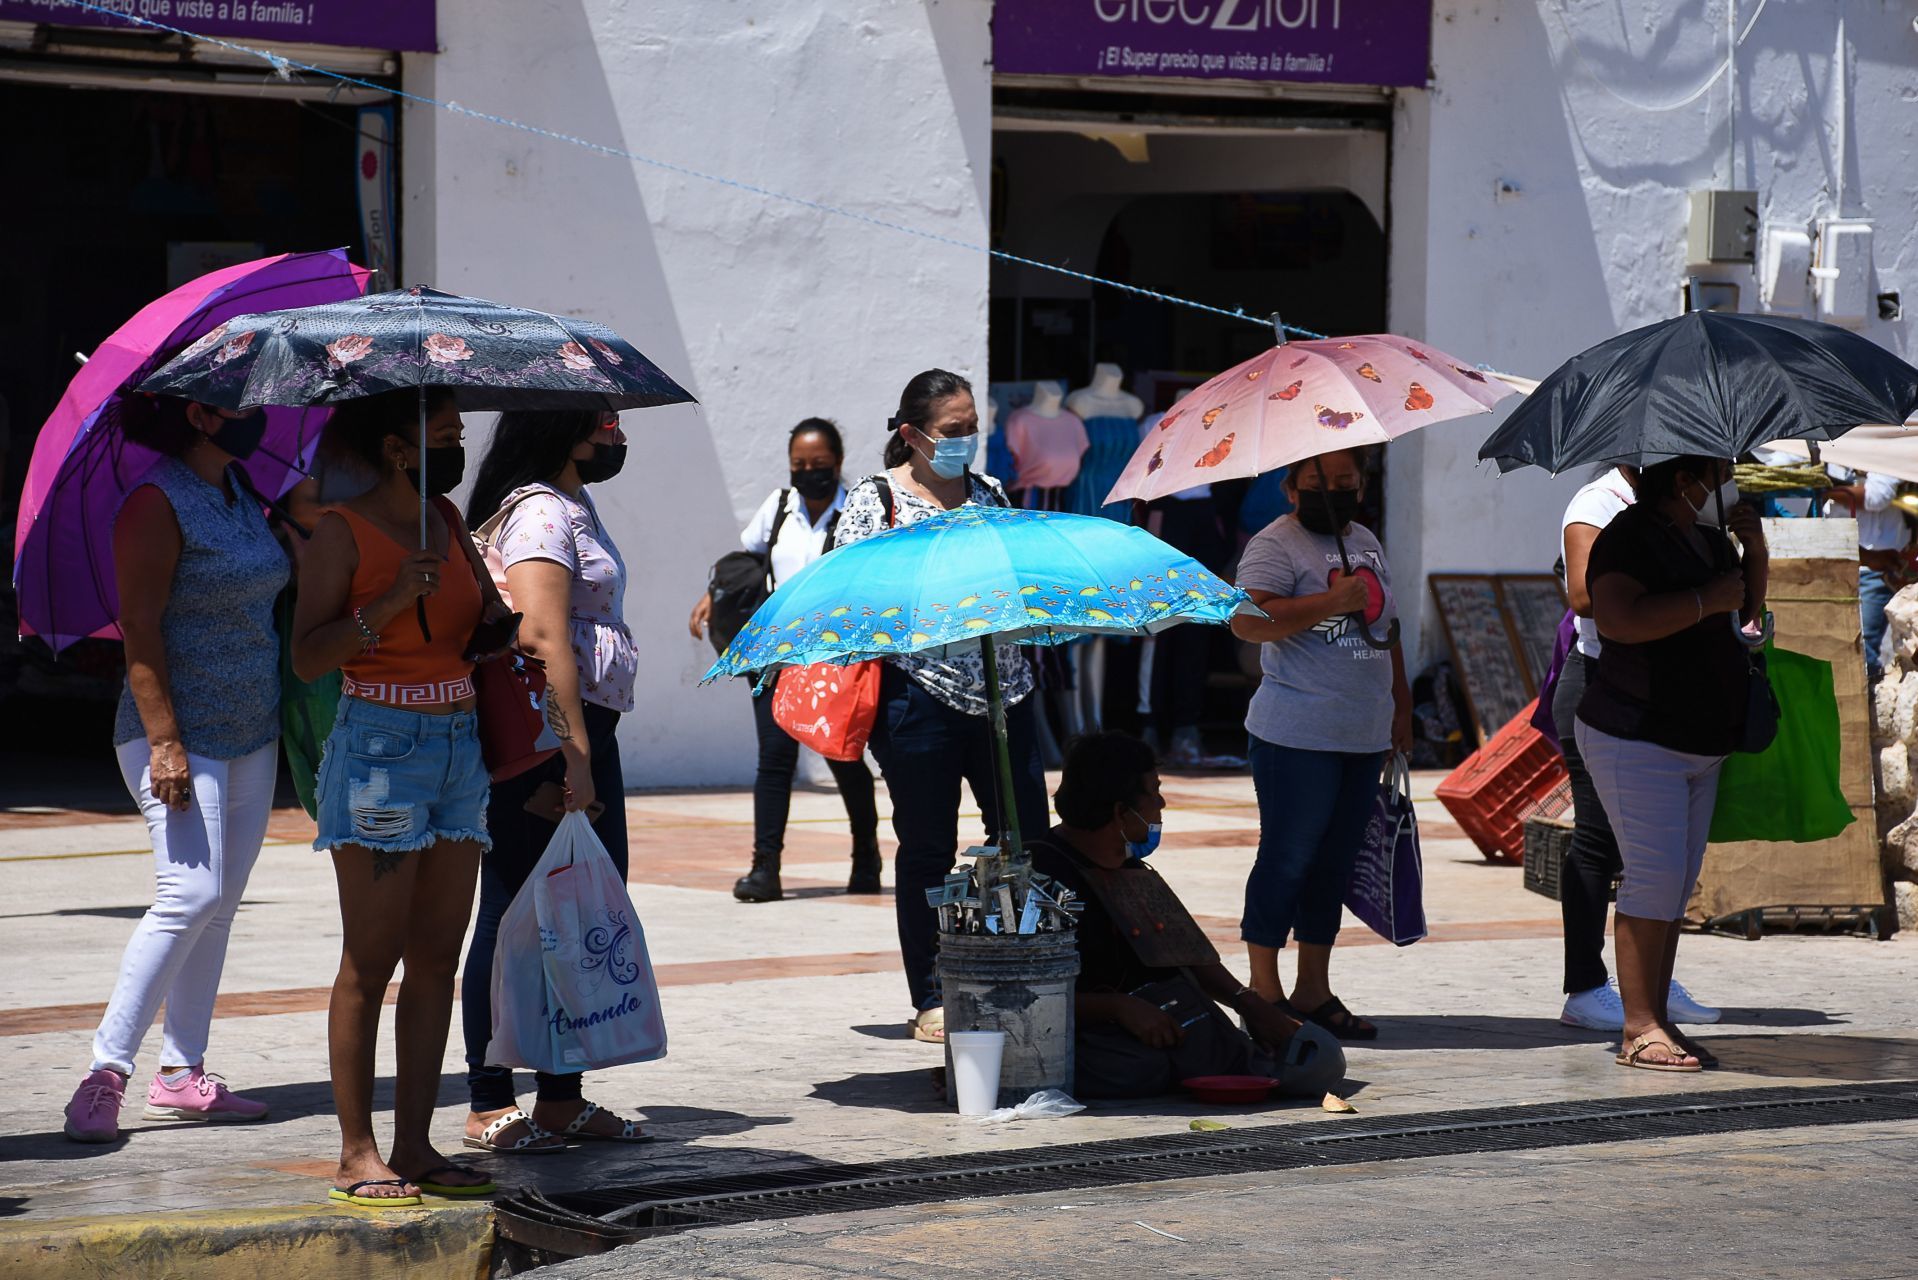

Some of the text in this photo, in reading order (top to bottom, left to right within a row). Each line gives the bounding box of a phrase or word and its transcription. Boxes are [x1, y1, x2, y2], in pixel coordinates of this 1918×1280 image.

[139, 0, 171, 17] que
[177, 0, 214, 19] viste
[218, 3, 228, 20] a
[232, 0, 246, 21] la
[251, 0, 303, 24] familia
[1121, 46, 1158, 71] Super
[1159, 49, 1200, 72] precio
[1201, 54, 1226, 73] que
[1228, 51, 1258, 71] viste
[1259, 56, 1269, 71] a
[1270, 52, 1283, 71] la
[1283, 52, 1326, 72] familia
[549, 992, 642, 1036] Armando
